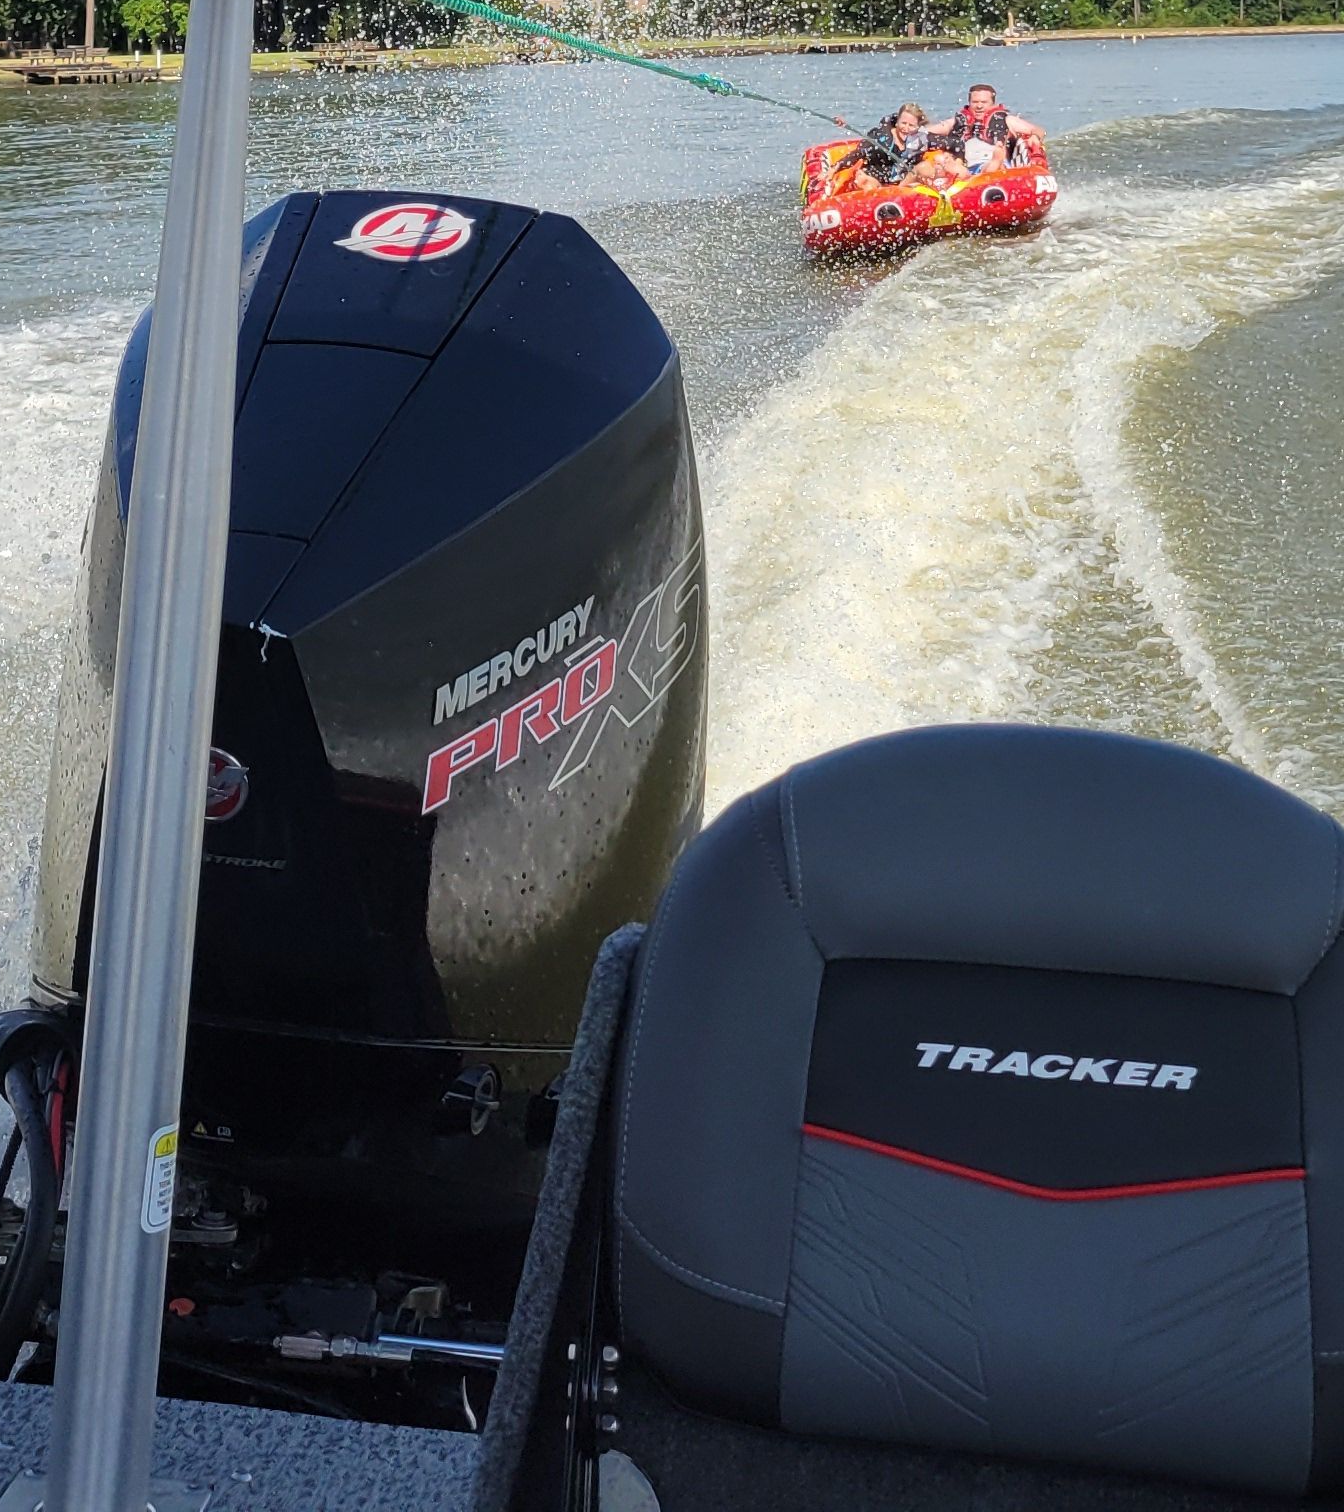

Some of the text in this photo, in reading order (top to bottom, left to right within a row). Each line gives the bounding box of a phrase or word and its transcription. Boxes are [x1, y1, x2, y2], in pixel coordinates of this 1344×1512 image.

[433, 594, 595, 725] MERCURY
[421, 638, 617, 815] PRO
[915, 1042, 1198, 1090] TRACKER
